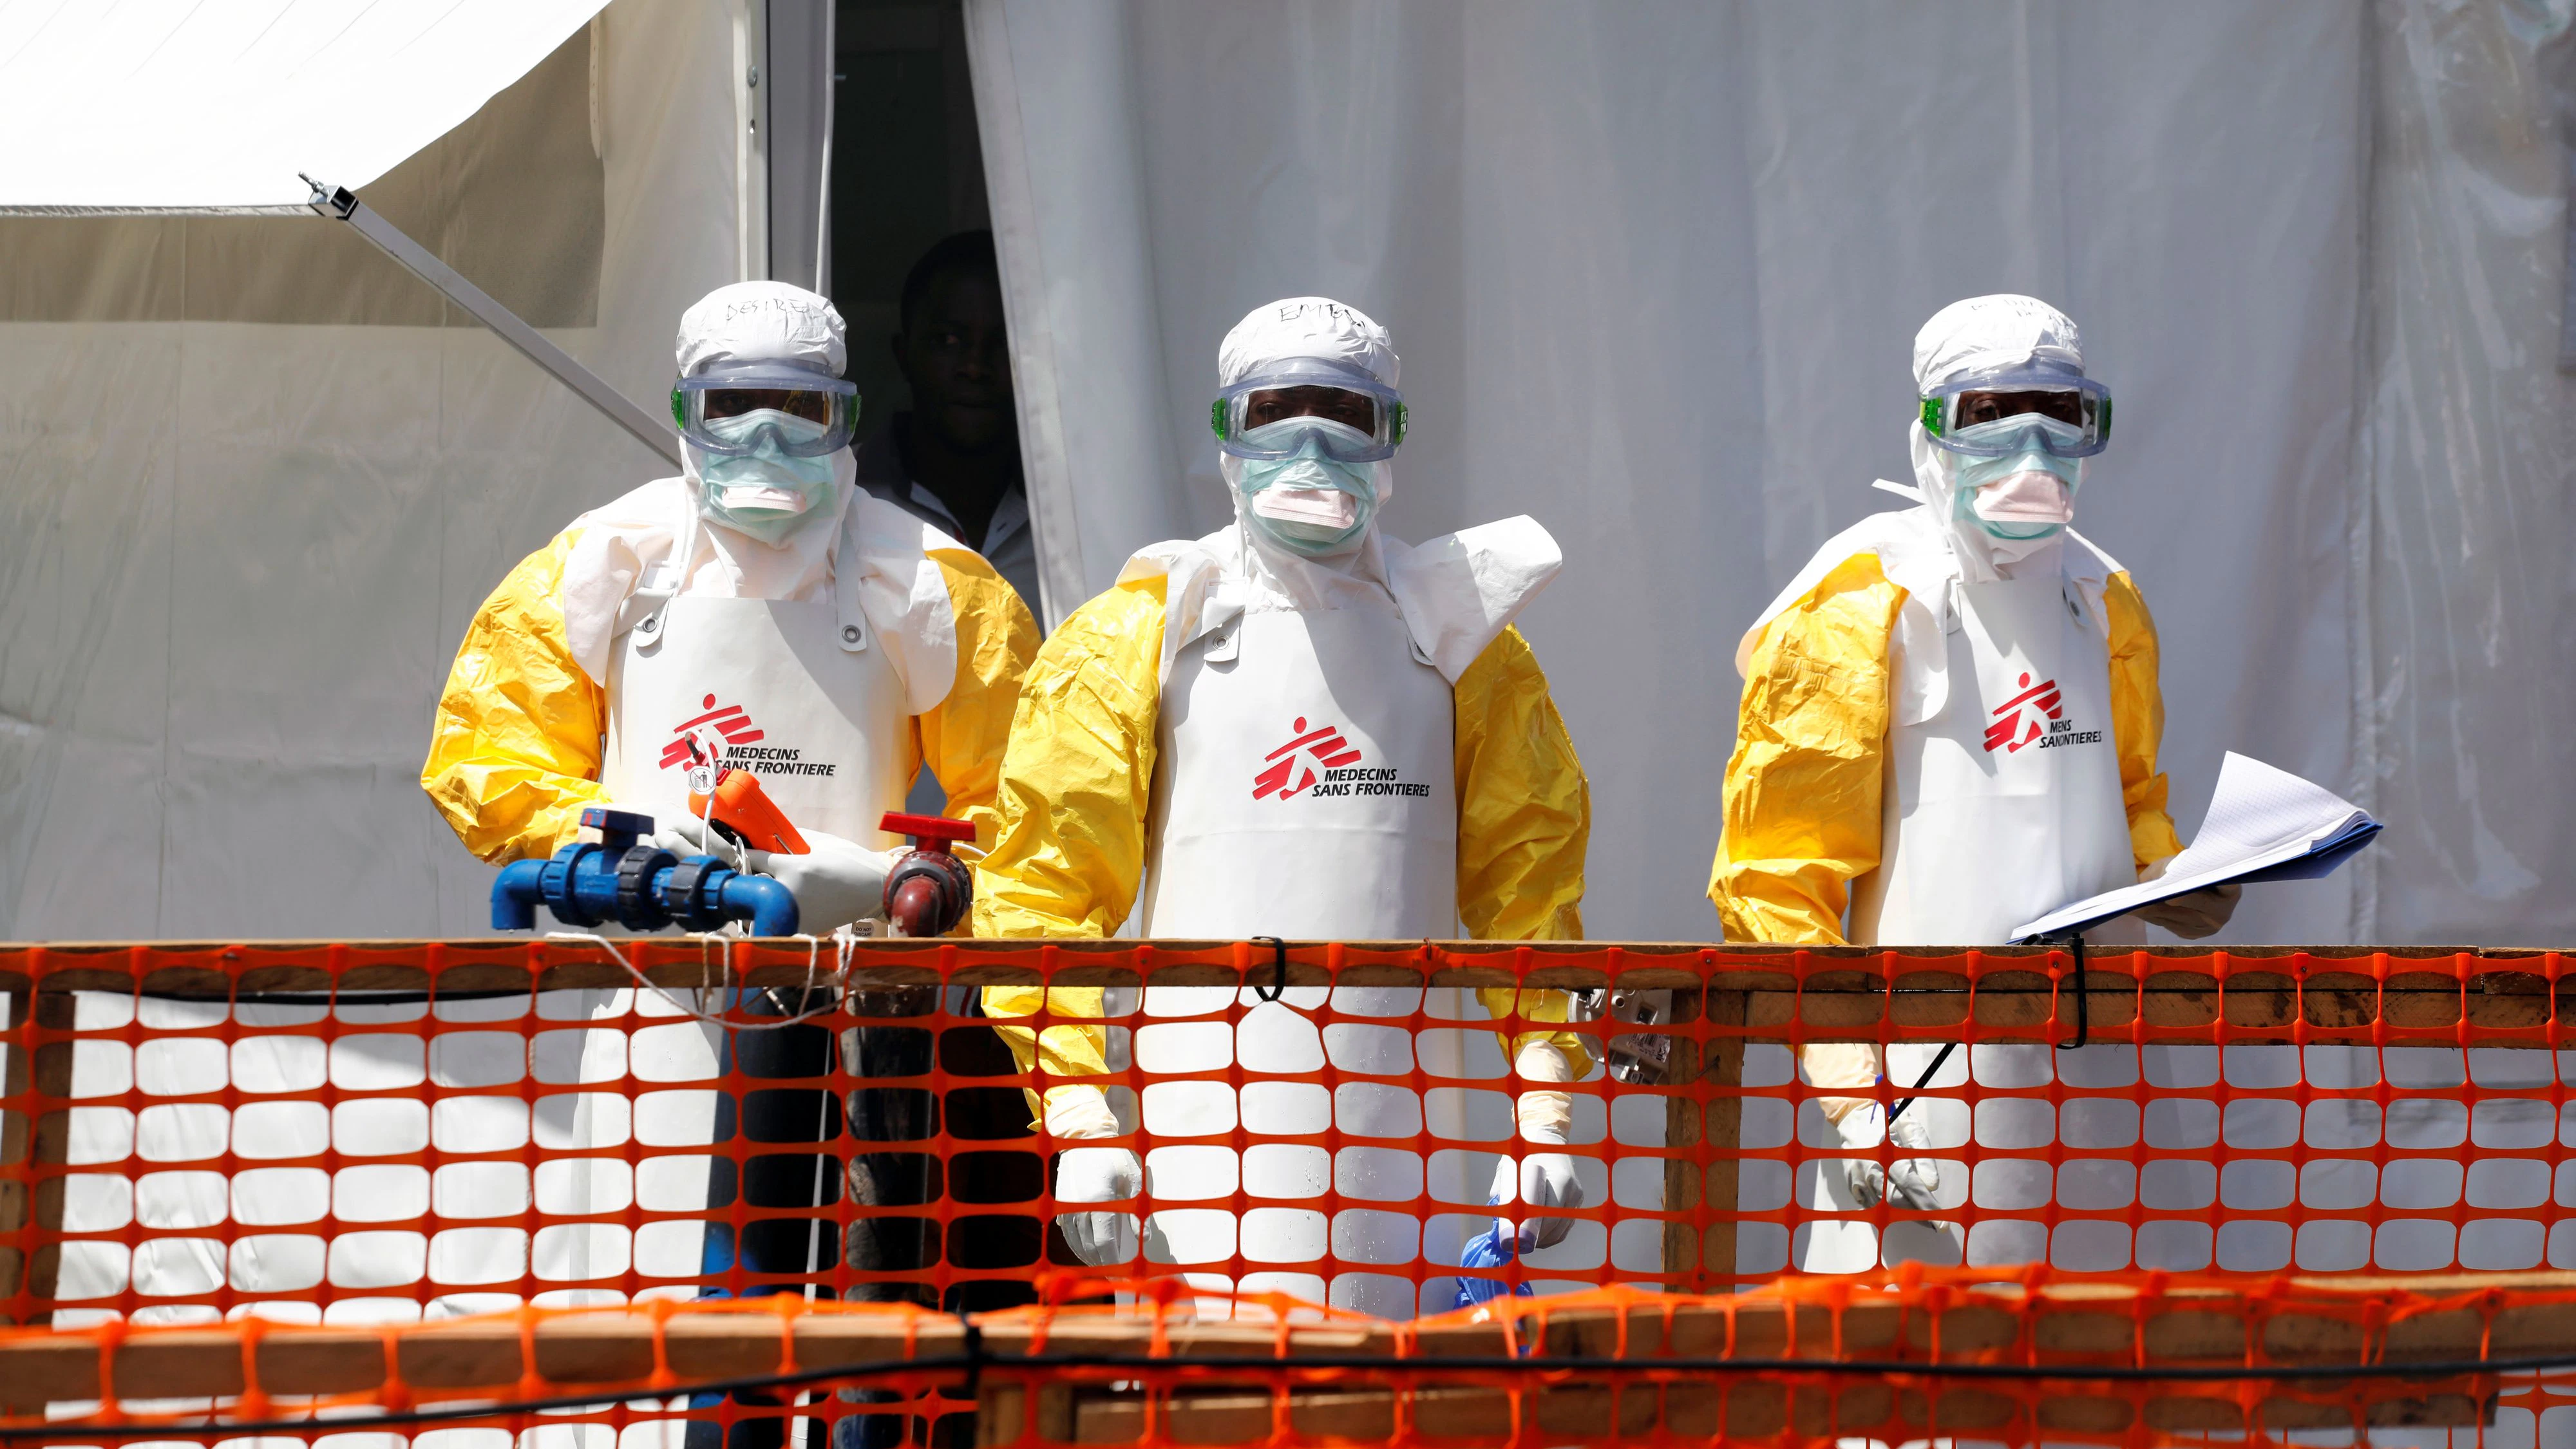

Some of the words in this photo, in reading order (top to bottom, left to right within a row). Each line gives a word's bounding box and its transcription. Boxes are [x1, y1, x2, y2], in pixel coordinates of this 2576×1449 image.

[726, 746, 800, 761] MEDECINS
[754, 762, 836, 776] FRONTIERE
[1325, 768, 1397, 782] MEDECINS
[1312, 783, 1350, 797] SANS
[1355, 782, 1430, 797] FRONTIERES
